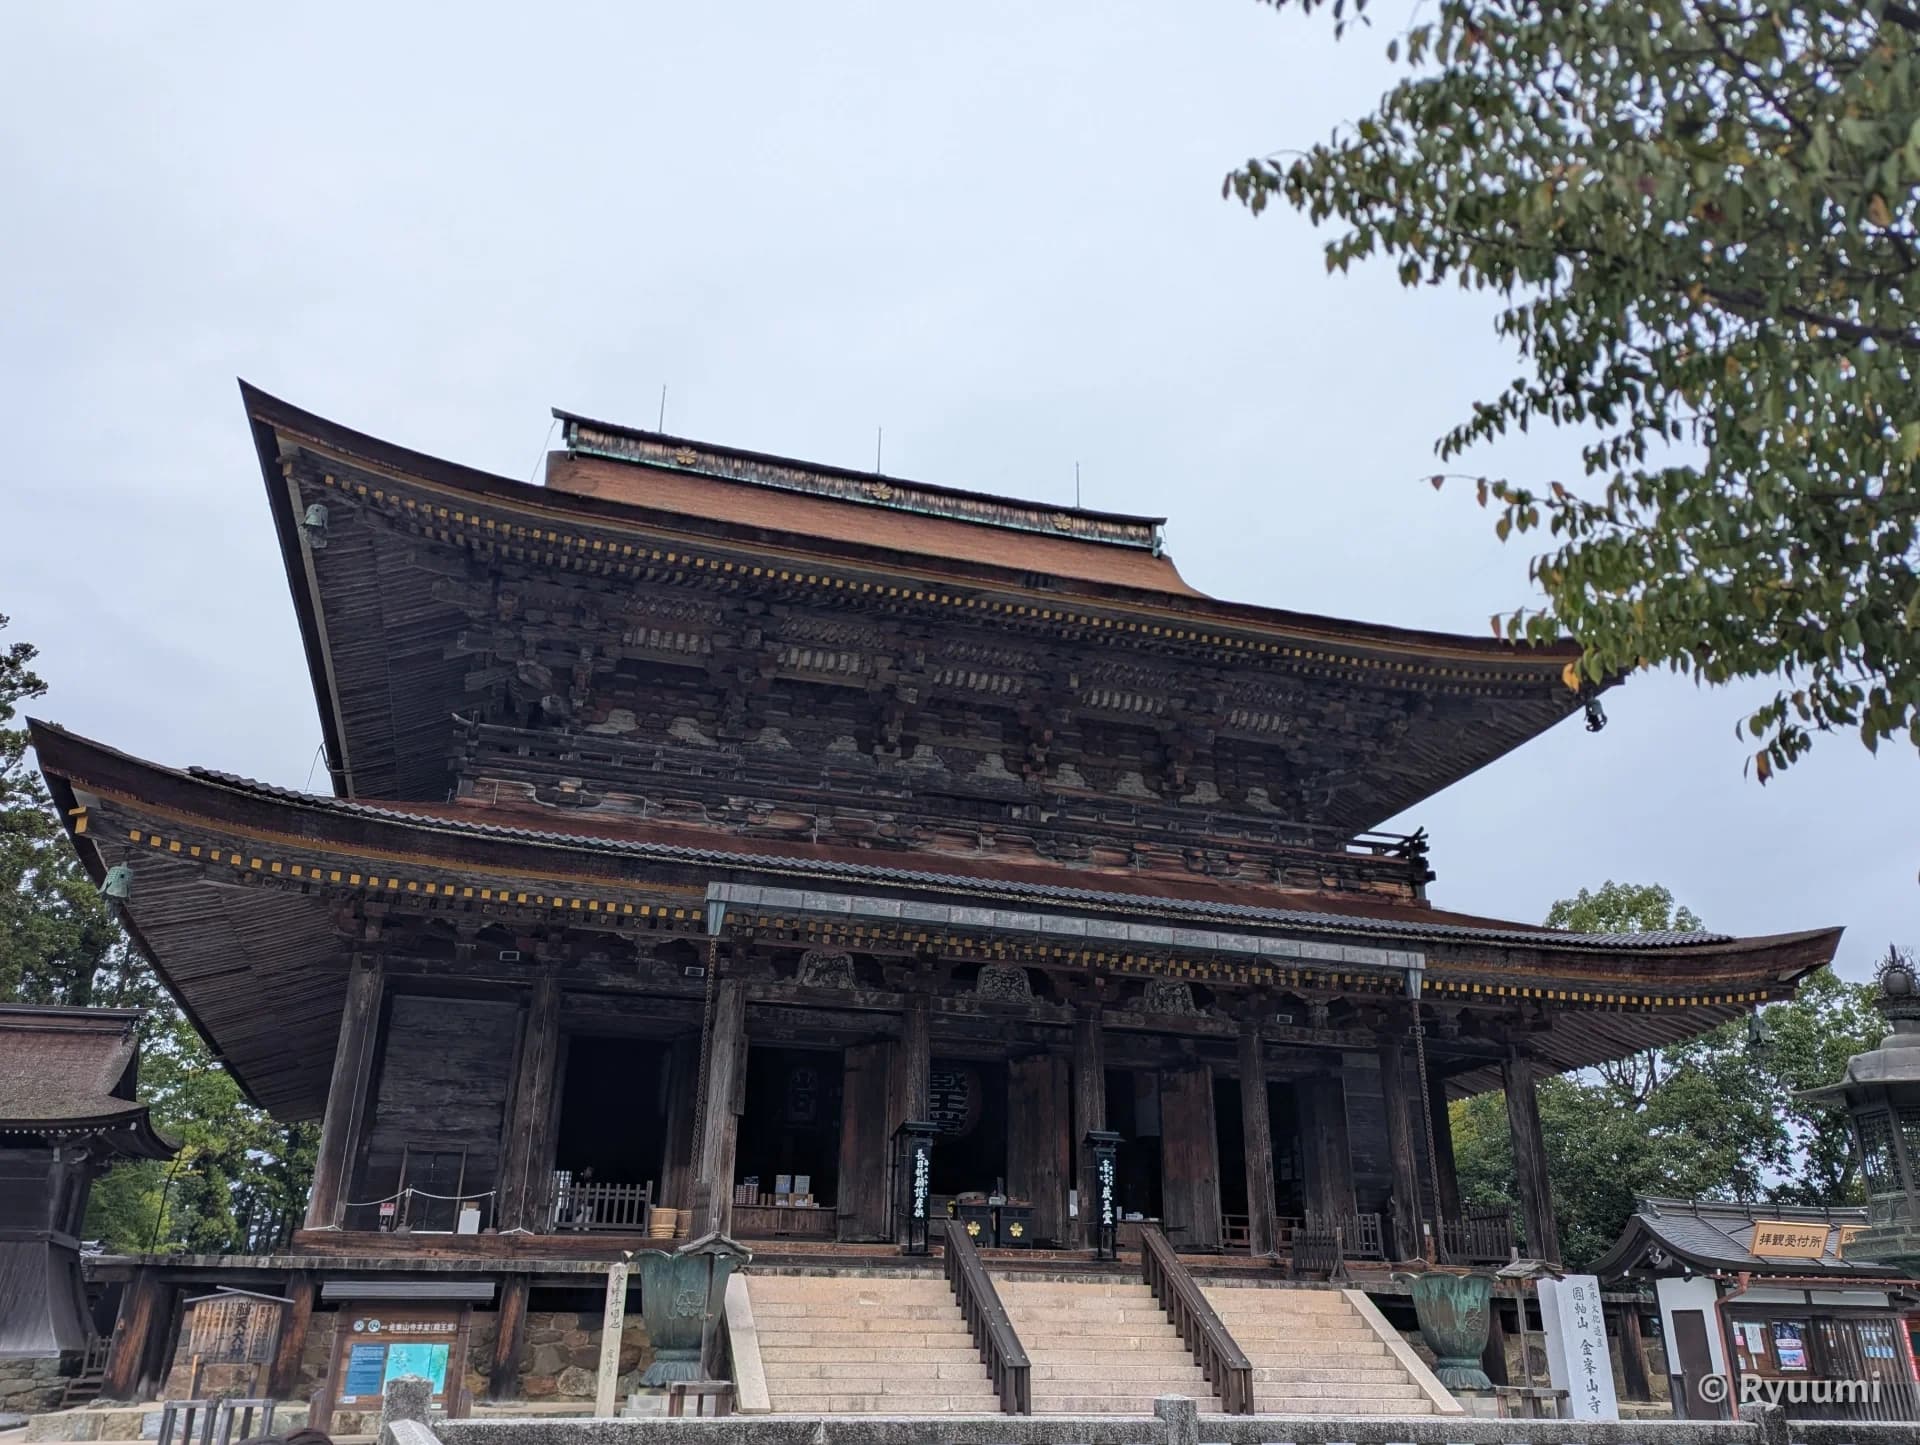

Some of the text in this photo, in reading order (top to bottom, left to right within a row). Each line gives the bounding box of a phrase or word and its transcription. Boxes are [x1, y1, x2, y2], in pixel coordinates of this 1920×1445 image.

[1759, 1232, 1822, 1249] 拝観受付所
